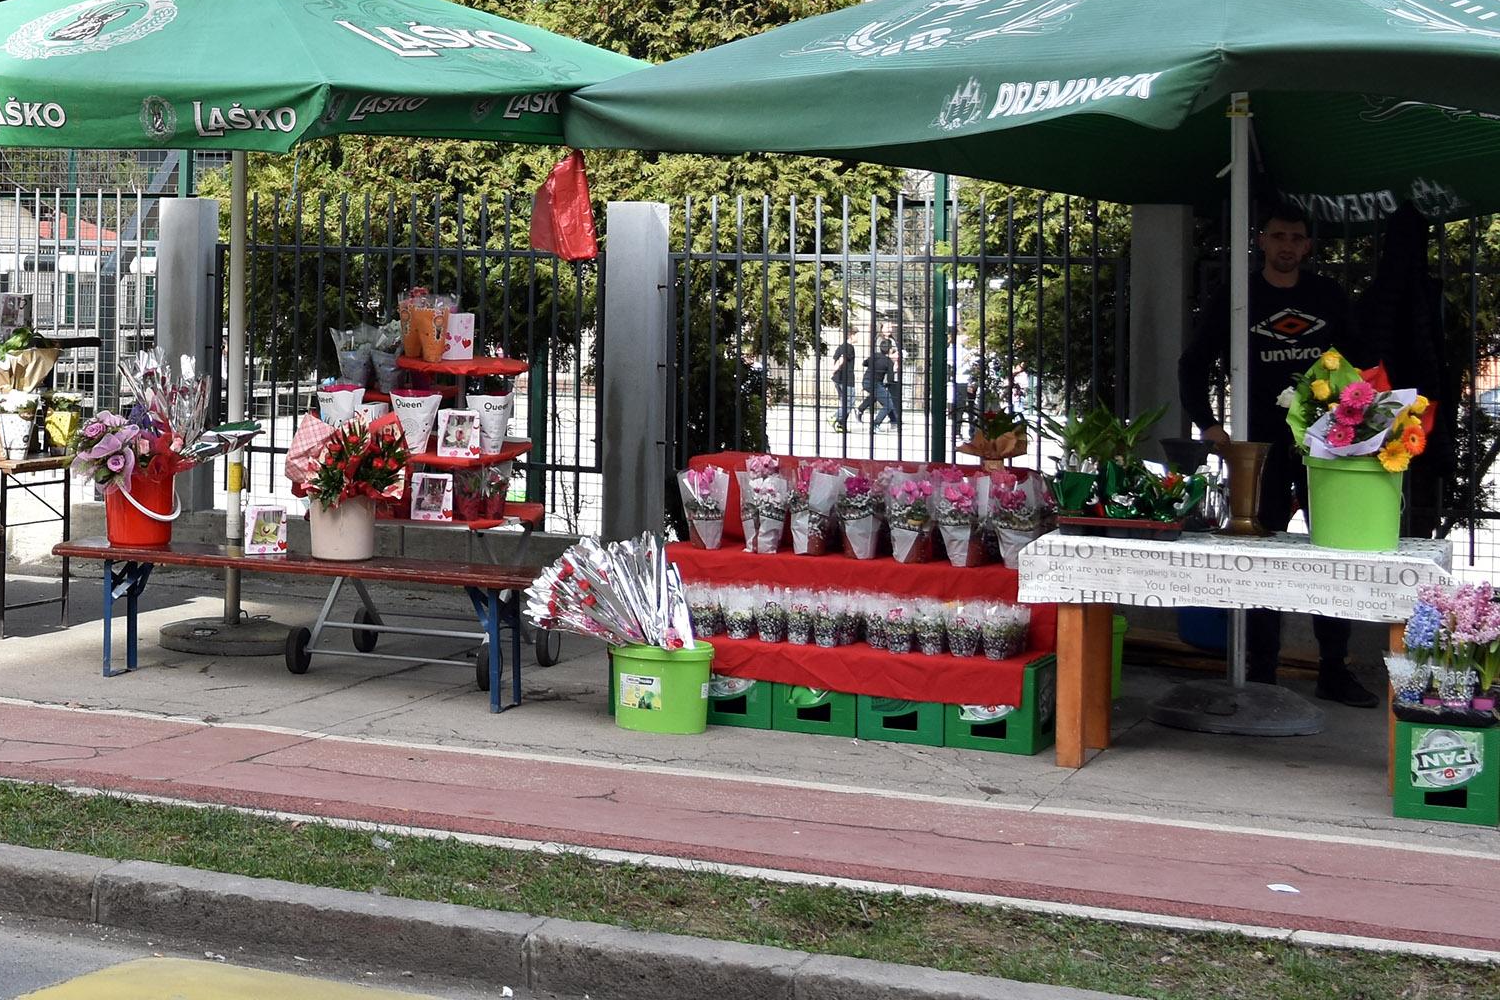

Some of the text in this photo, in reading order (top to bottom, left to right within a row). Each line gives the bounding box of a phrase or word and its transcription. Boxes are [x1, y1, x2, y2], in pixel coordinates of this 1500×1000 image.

[334, 20, 534, 58] LAŠKO
[192, 101, 297, 137] LAŠKO
[1260, 346, 1322, 362] umbro
[395, 398, 423, 409] Queen
[1049, 561, 1073, 571] How
[1179, 571, 1192, 580] OK
[1206, 573, 1232, 584] How
[1235, 578, 1251, 586] are
[1341, 583, 1356, 593] OK
[1370, 587, 1397, 599] How
[1112, 548, 1128, 558] BE
[1130, 549, 1168, 561] COOL
[1168, 550, 1254, 573] HELLO
[1273, 560, 1290, 570] BE
[1292, 561, 1331, 575] COOL
[1331, 562, 1421, 588] HELLO
[1036, 572, 1065, 584] good
[1145, 580, 1165, 590] You
[1169, 581, 1190, 593] feel
[1194, 585, 1223, 596] good
[1306, 594, 1328, 606] You
[1331, 596, 1354, 608] feel
[1356, 599, 1388, 611] good
[1420, 749, 1472, 767] PAN
